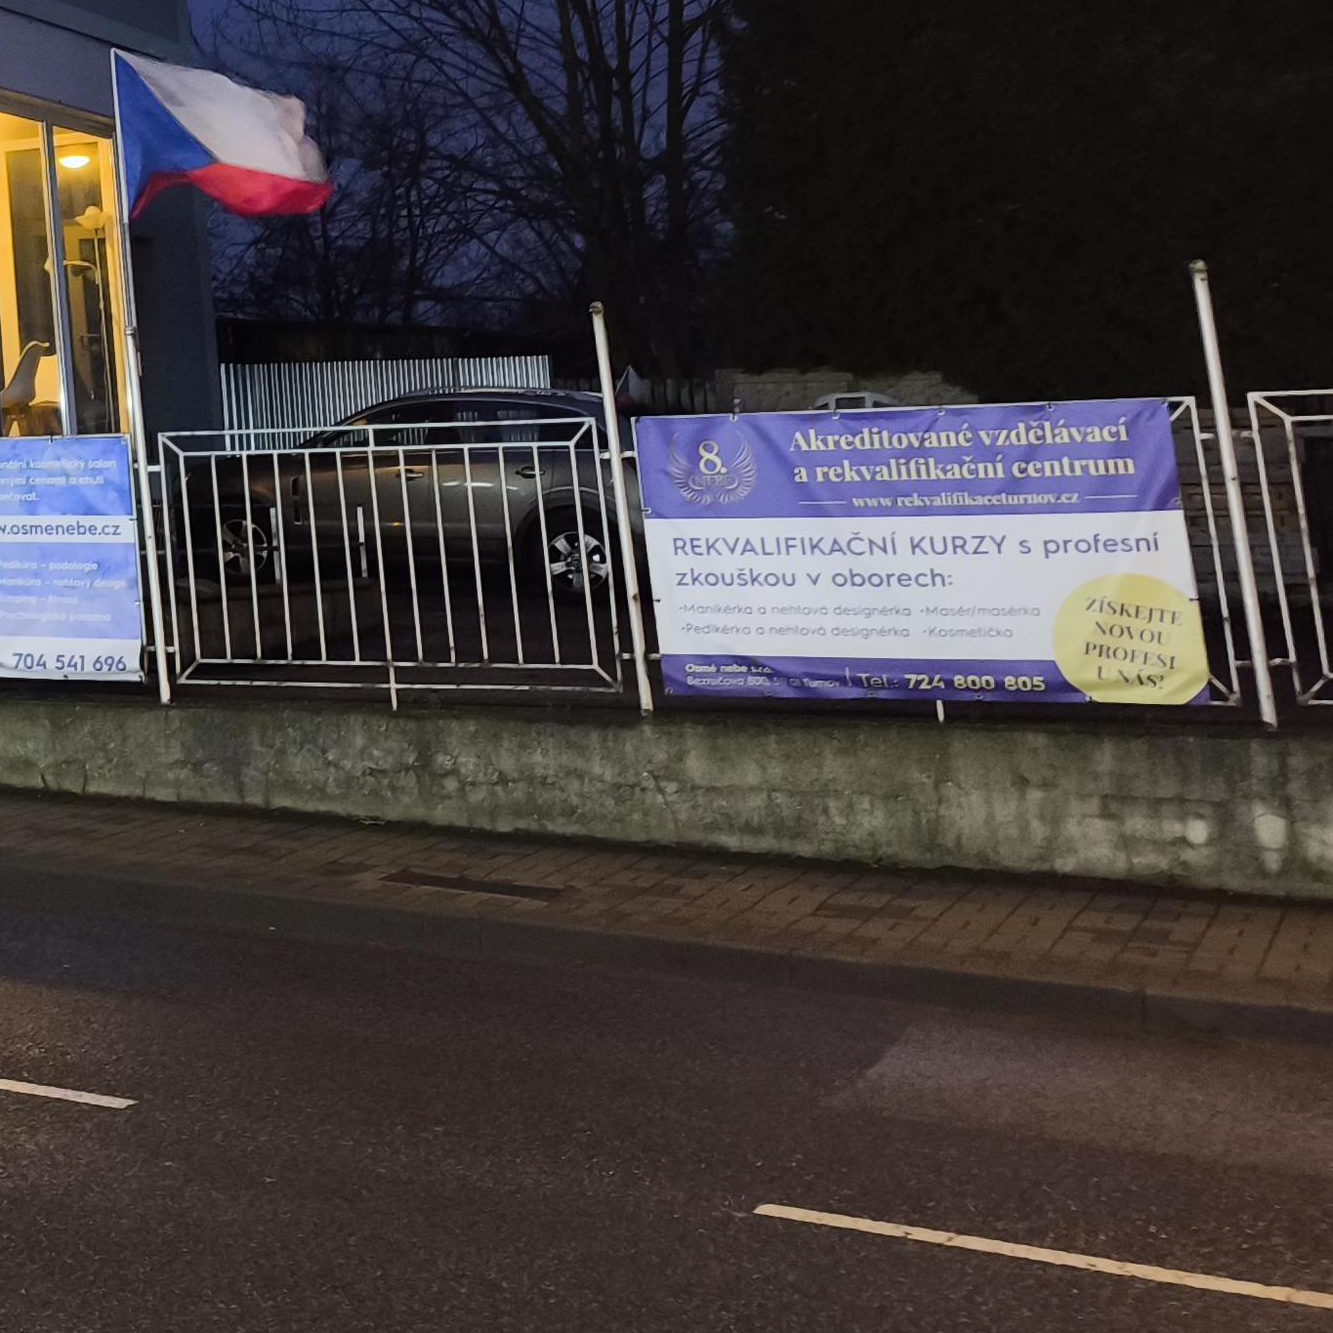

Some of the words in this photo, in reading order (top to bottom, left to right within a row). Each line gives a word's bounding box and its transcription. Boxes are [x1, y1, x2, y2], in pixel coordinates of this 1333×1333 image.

[789, 424, 973, 452] Akreditované
[978, 416, 1129, 446] vzdělávací
[793, 467, 809, 483] a
[816, 455, 1006, 483] rekvalifikační
[1012, 457, 1136, 478] centrum
[852, 492, 1079, 508] wwwrekvalifikaceturnov.cz
[672, 531, 897, 556] REKVALIFIKAČNÍ
[910, 534, 1007, 556] KURZY
[1018, 539, 1032, 555] s
[1043, 532, 1160, 559] profesní
[675, 567, 796, 587] zkouškou
[806, 572, 822, 587] v
[832, 567, 954, 588] oborech:
[1085, 596, 1183, 626] ZÍSKEJTE
[1095, 620, 1169, 646] NOVOU
[12, 652, 47, 670] 704
[55, 654, 85, 671] 541
[92, 655, 127, 672] 696
[1084, 641, 1176, 670] PROFESI
[904, 673, 945, 690] 724
[953, 674, 995, 690] 800
[1004, 675, 1046, 691] 805
